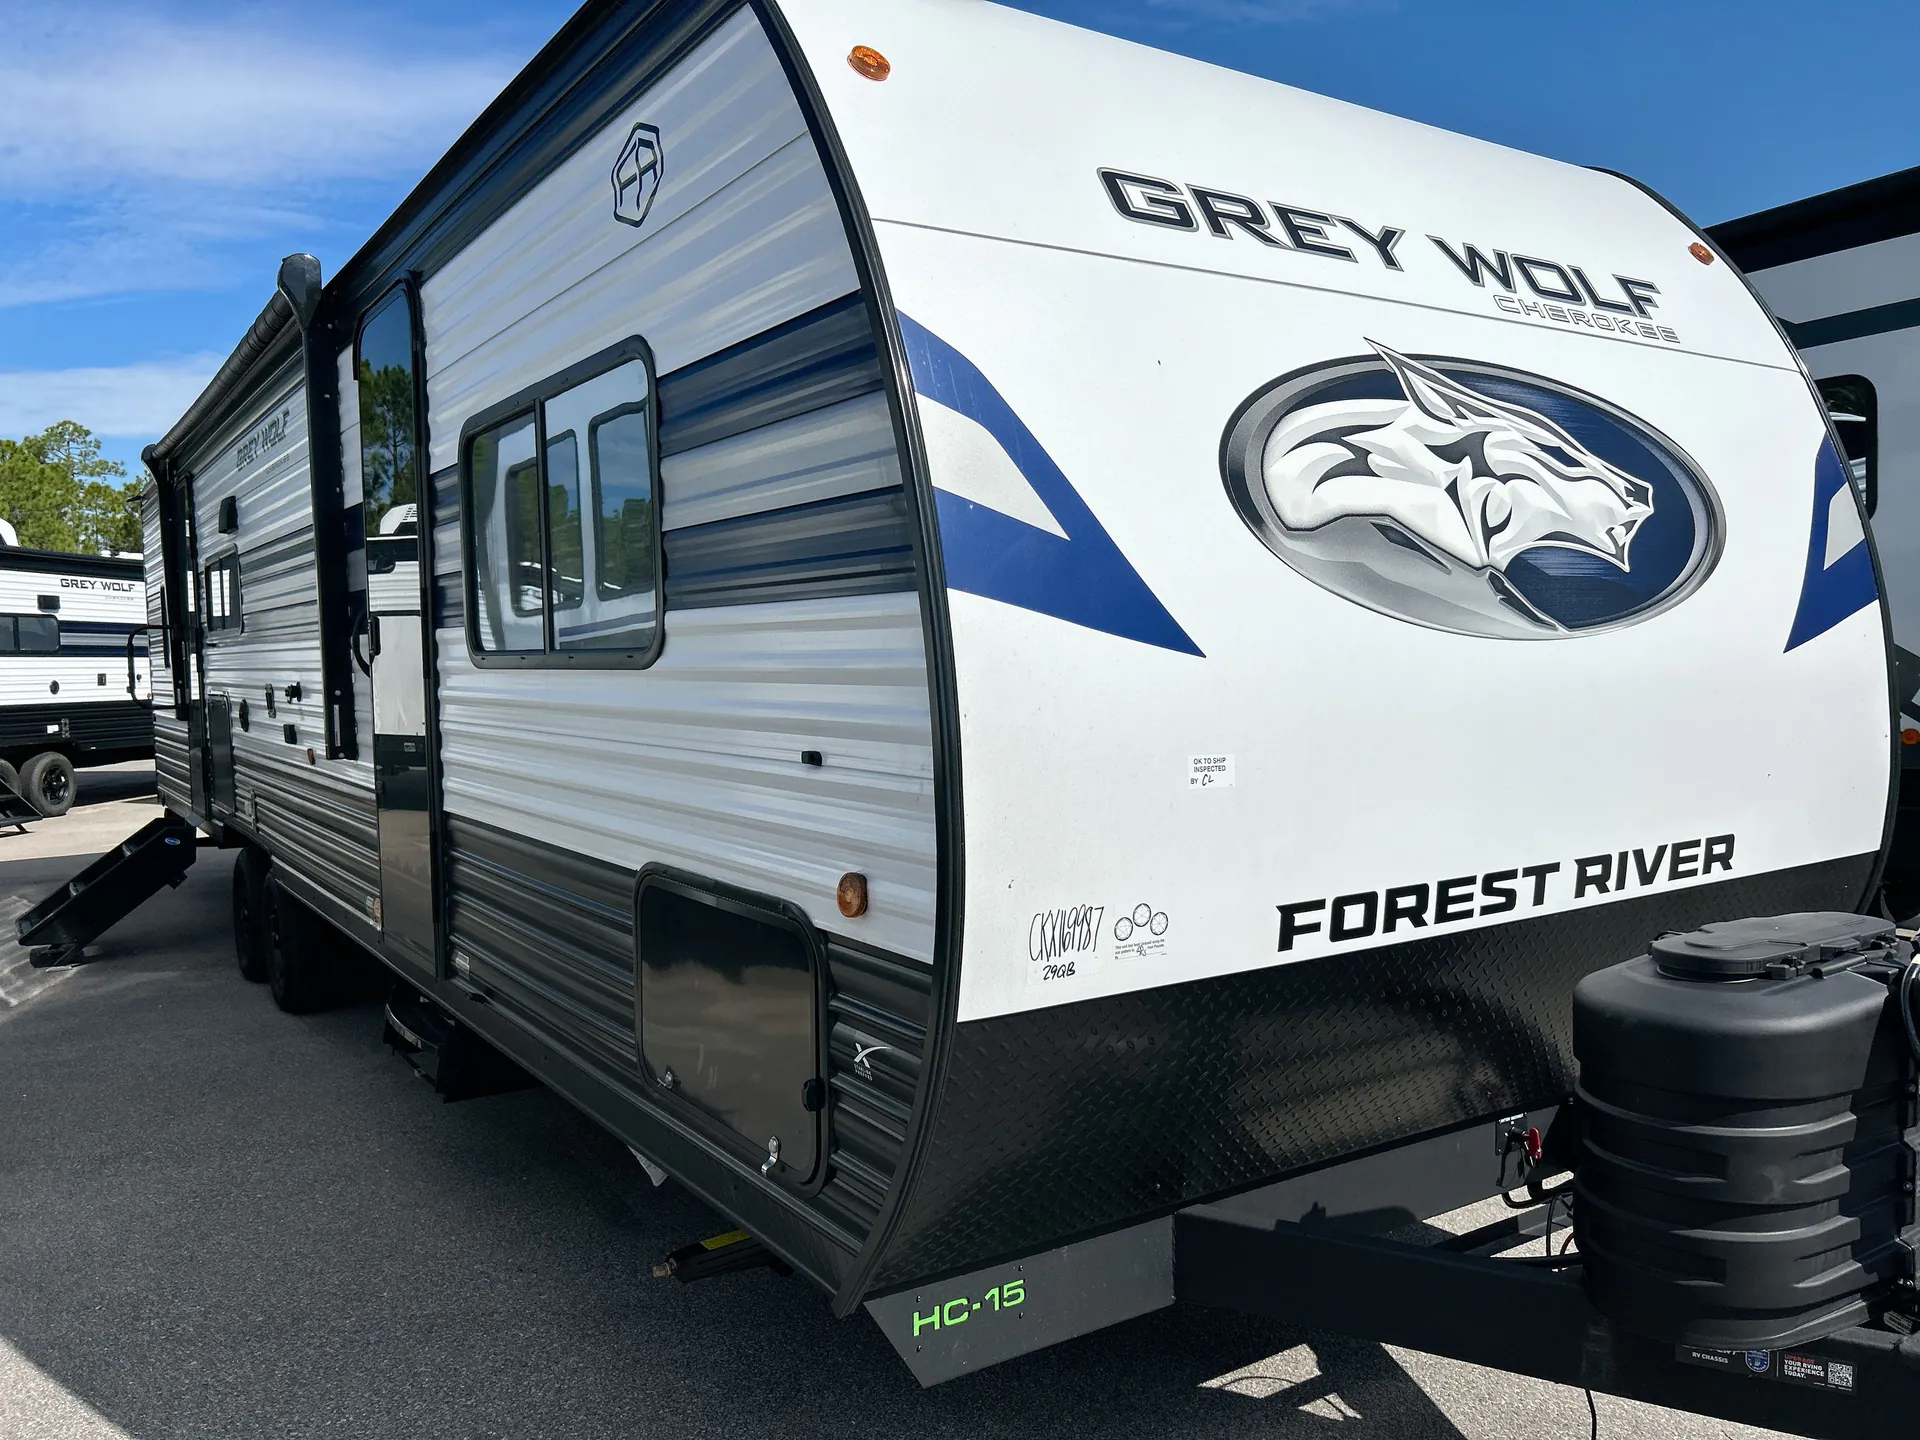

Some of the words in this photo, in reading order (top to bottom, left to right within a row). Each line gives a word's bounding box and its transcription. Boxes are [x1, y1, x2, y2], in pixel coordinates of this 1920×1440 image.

[1097, 167, 1405, 271] GREY
[1425, 235, 1660, 320] WOLF
[1493, 294, 1680, 343] CHEROKEE
[236, 431, 260, 471] GREY
[261, 408, 290, 452] WOLF
[60, 578, 97, 590] GREY
[100, 581, 135, 592] WOLF
[1275, 862, 1561, 952] FOREST
[1574, 833, 1736, 899] RIVER
[912, 1278, 1026, 1337] HC-15
[1702, 1354, 1729, 1364] CHASSIS
[1784, 1365, 1825, 1377] EXPERIENCE
[1784, 1370, 1806, 1379] TODAY.
[1803, 1363, 1823, 1371] RVING
